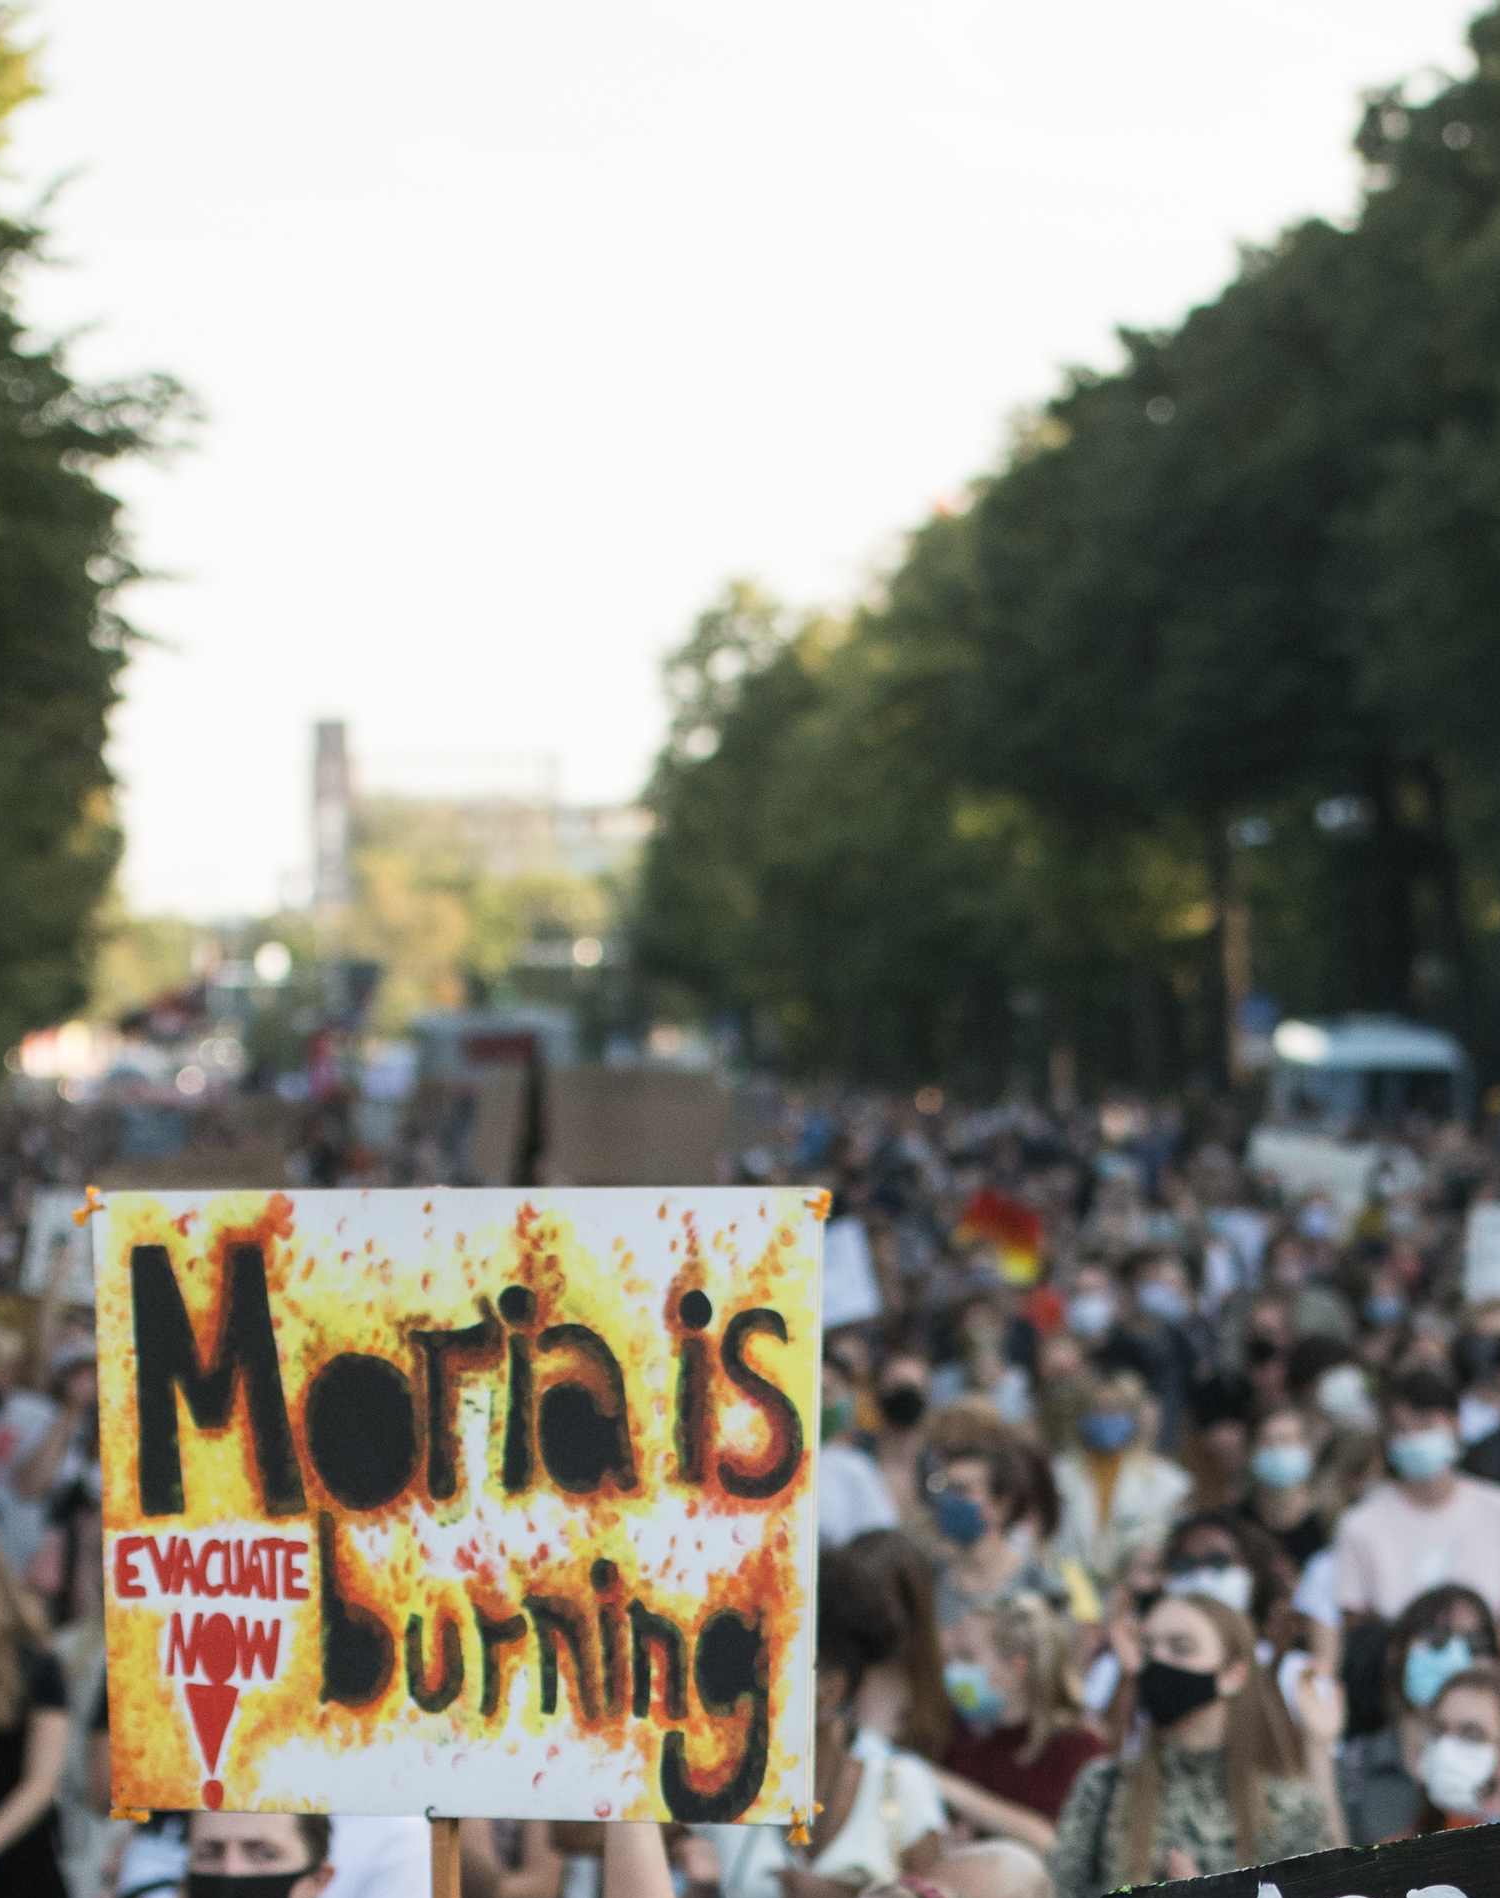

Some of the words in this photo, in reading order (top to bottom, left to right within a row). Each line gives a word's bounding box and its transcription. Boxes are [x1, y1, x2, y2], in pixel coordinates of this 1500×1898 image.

[130, 1244, 638, 1516] Moria
[675, 1288, 804, 1500] is
[113, 1536, 311, 1600] EVACUATE
[165, 1611, 281, 1684] NOW
[318, 1509, 770, 1824] burning
